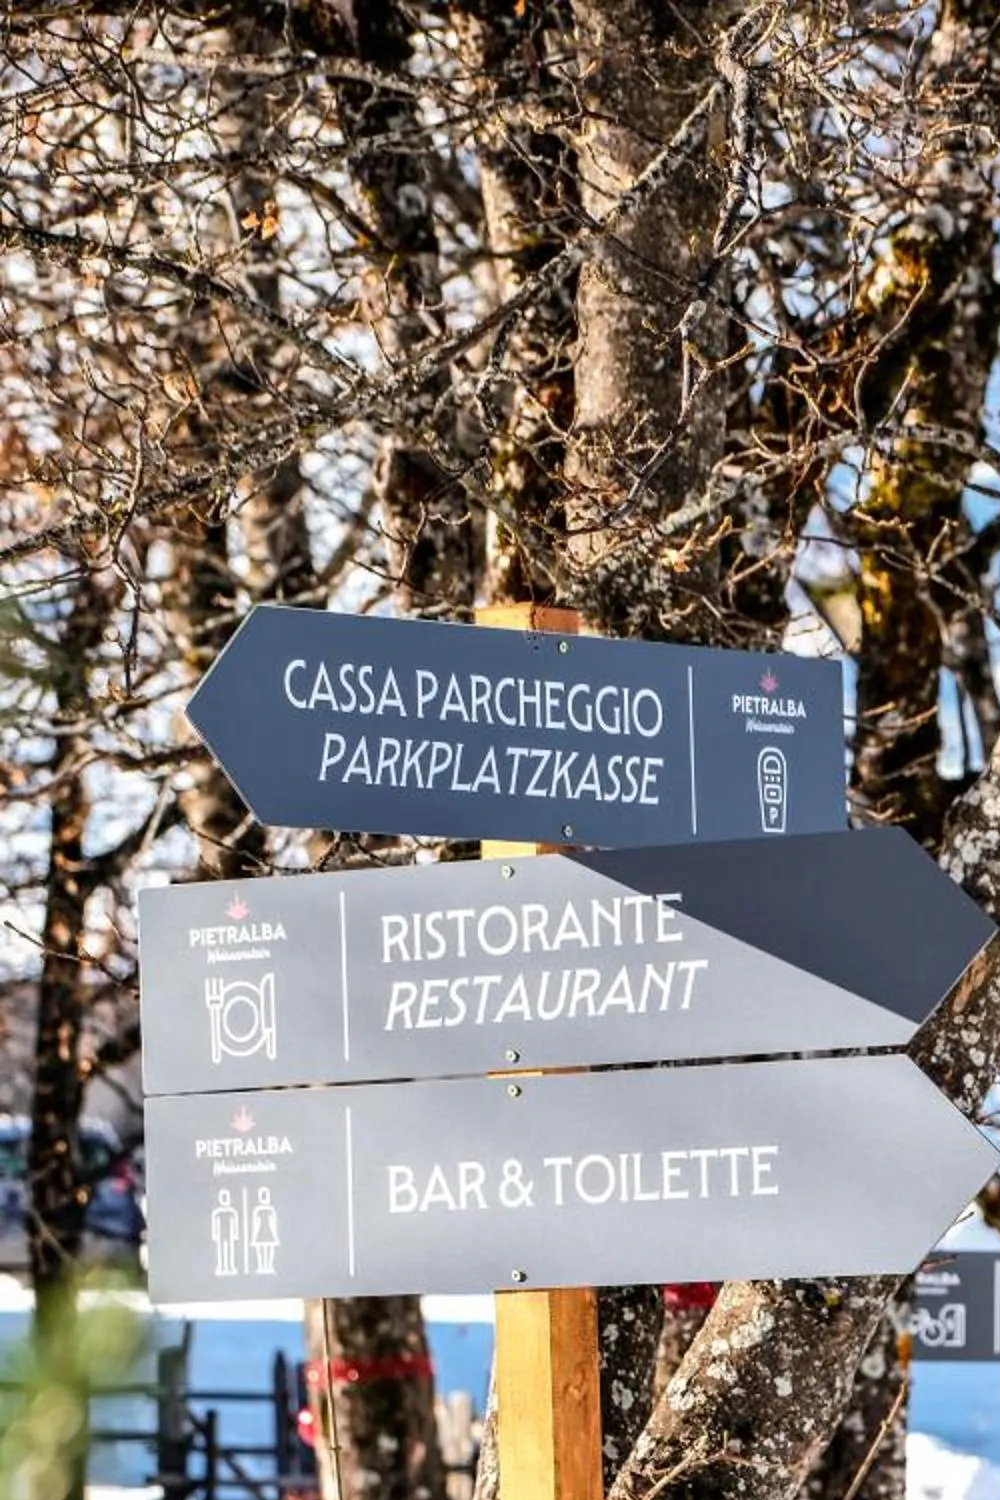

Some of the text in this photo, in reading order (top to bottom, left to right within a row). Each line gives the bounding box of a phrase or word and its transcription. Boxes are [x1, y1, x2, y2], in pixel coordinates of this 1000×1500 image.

[284, 659, 663, 737] CASSA PARCHEGGIO
[732, 694, 807, 719] PIETRALBA
[319, 733, 664, 805] PARKPLATZKASSE
[189, 922, 287, 948] PIETRALBA
[381, 893, 683, 963] RISTORANTE
[384, 959, 709, 1031] RESTAURANT
[195, 1135, 294, 1160] PIETRALBA
[387, 1145, 780, 1214] BAR & TOILETTE
